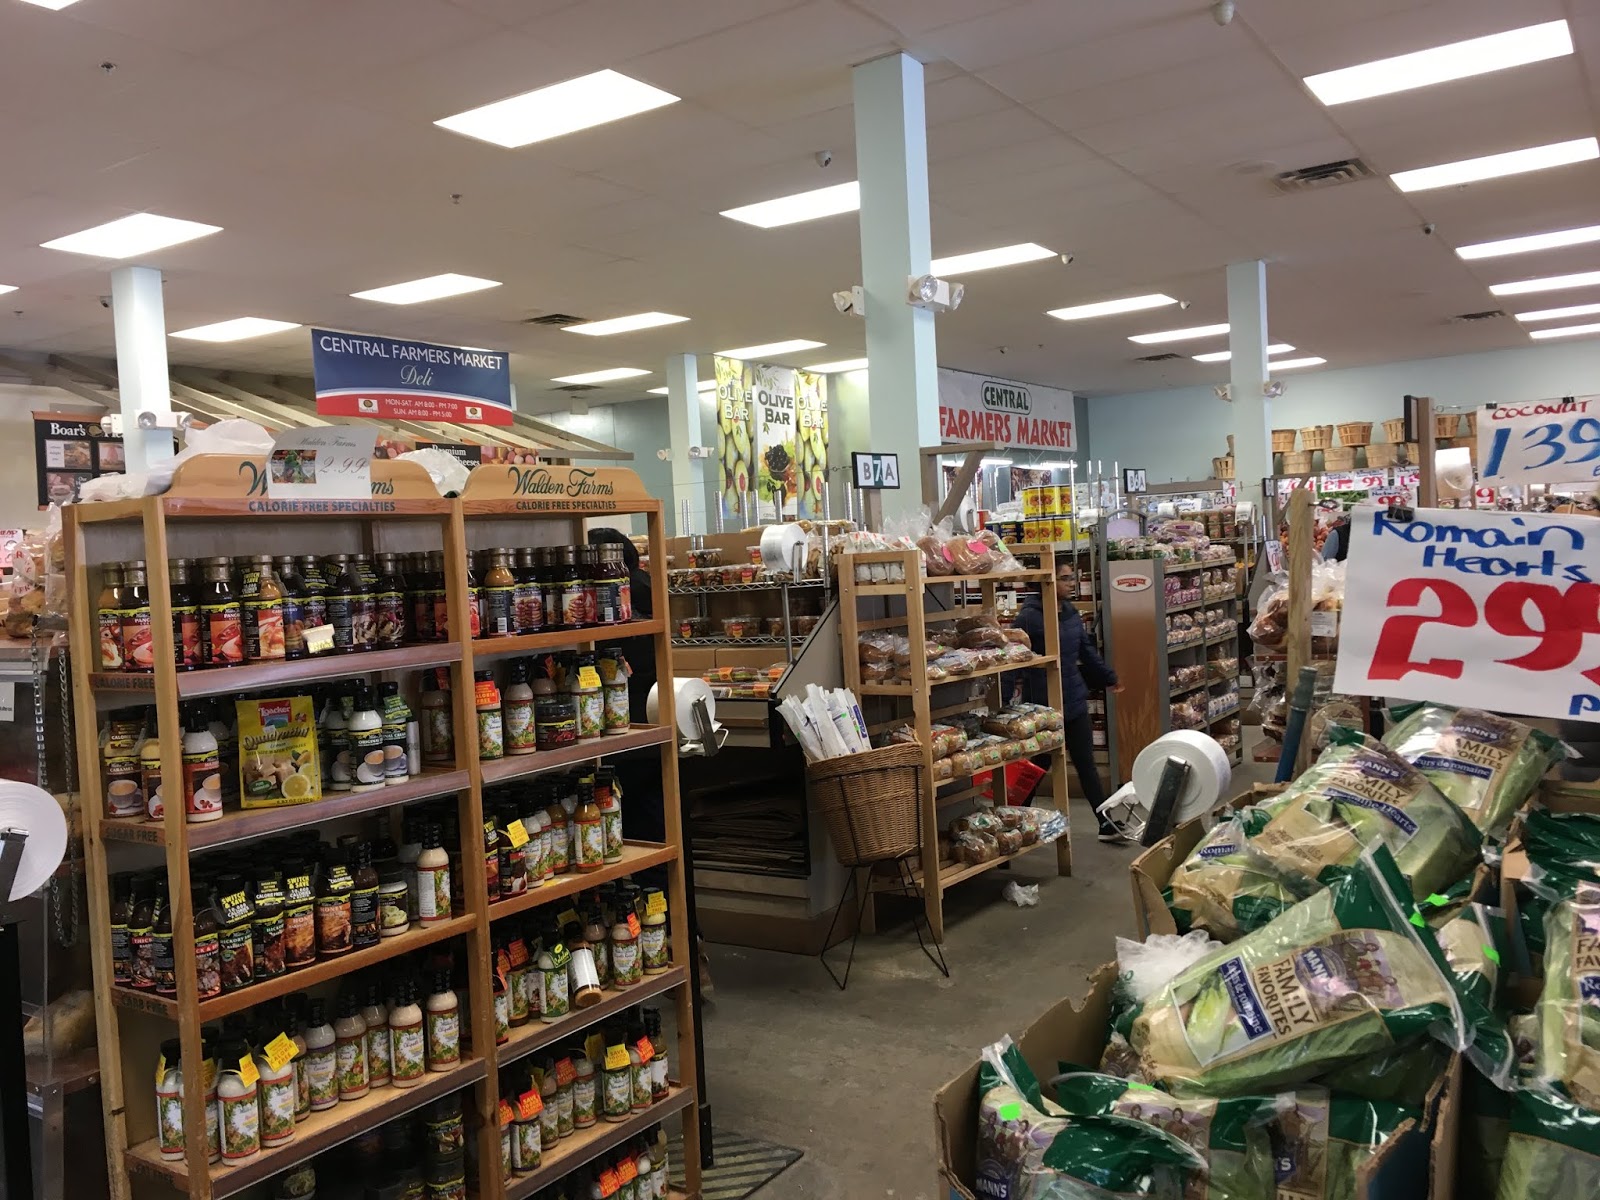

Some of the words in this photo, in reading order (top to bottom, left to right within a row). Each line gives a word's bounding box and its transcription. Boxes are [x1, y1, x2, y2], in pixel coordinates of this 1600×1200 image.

[320, 336, 389, 358] CENTRAL
[393, 345, 450, 365] FARMERS
[453, 353, 502, 370] MARKET
[400, 364, 433, 386] Deli
[758, 390, 793, 409] OLIVE
[983, 386, 1029, 410] CENTRAL
[724, 403, 750, 421] BAR
[765, 408, 790, 425] BAR
[1492, 400, 1592, 420] COCONUT
[50, 422, 86, 436] Boar's
[803, 415, 825, 429] BAR
[939, 406, 1011, 443] FARMERS
[1017, 416, 1072, 448] MARKET
[319, 456, 367, 474] 2.99
[507, 466, 565, 496] Walden
[566, 468, 614, 498] Farms
[249, 501, 301, 513] CALORIE
[302, 501, 329, 513] FREE
[332, 501, 396, 512] SPECIALTIES
[516, 500, 550, 510] CALORIE
[552, 500, 571, 510] FREE
[572, 500, 616, 510] SPECIALTIES
[1373, 510, 1584, 550] Romain
[1422, 545, 1592, 583] Hearts
[133, 677, 154, 689] FREE
[258, 706, 290, 717] Loacker
[1456, 738, 1509, 761] MILY
[1458, 750, 1503, 770] ORITES
[1359, 772, 1407, 799] MILY
[221, 891, 246, 904] SWITCH
[1256, 966, 1292, 1036] FAVORITES
